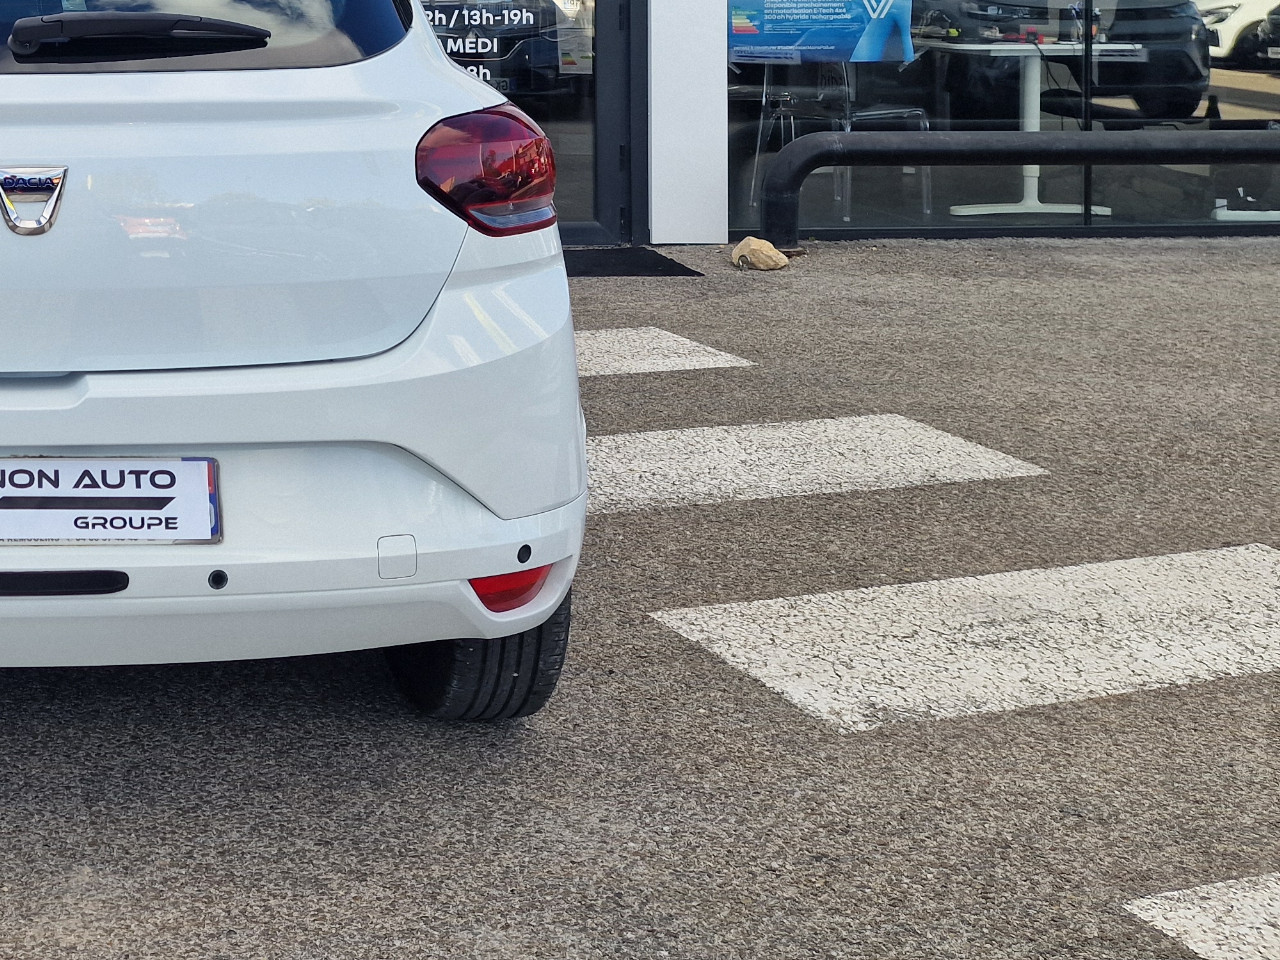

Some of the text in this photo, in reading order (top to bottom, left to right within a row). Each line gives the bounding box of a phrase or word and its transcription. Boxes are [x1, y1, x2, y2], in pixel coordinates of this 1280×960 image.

[462, 8, 534, 25] 13h-19h
[437, 37, 498, 54] MEDI
[3, 177, 56, 188] DACIA
[72, 469, 177, 490] AUTO
[73, 516, 178, 530] GROUPE
